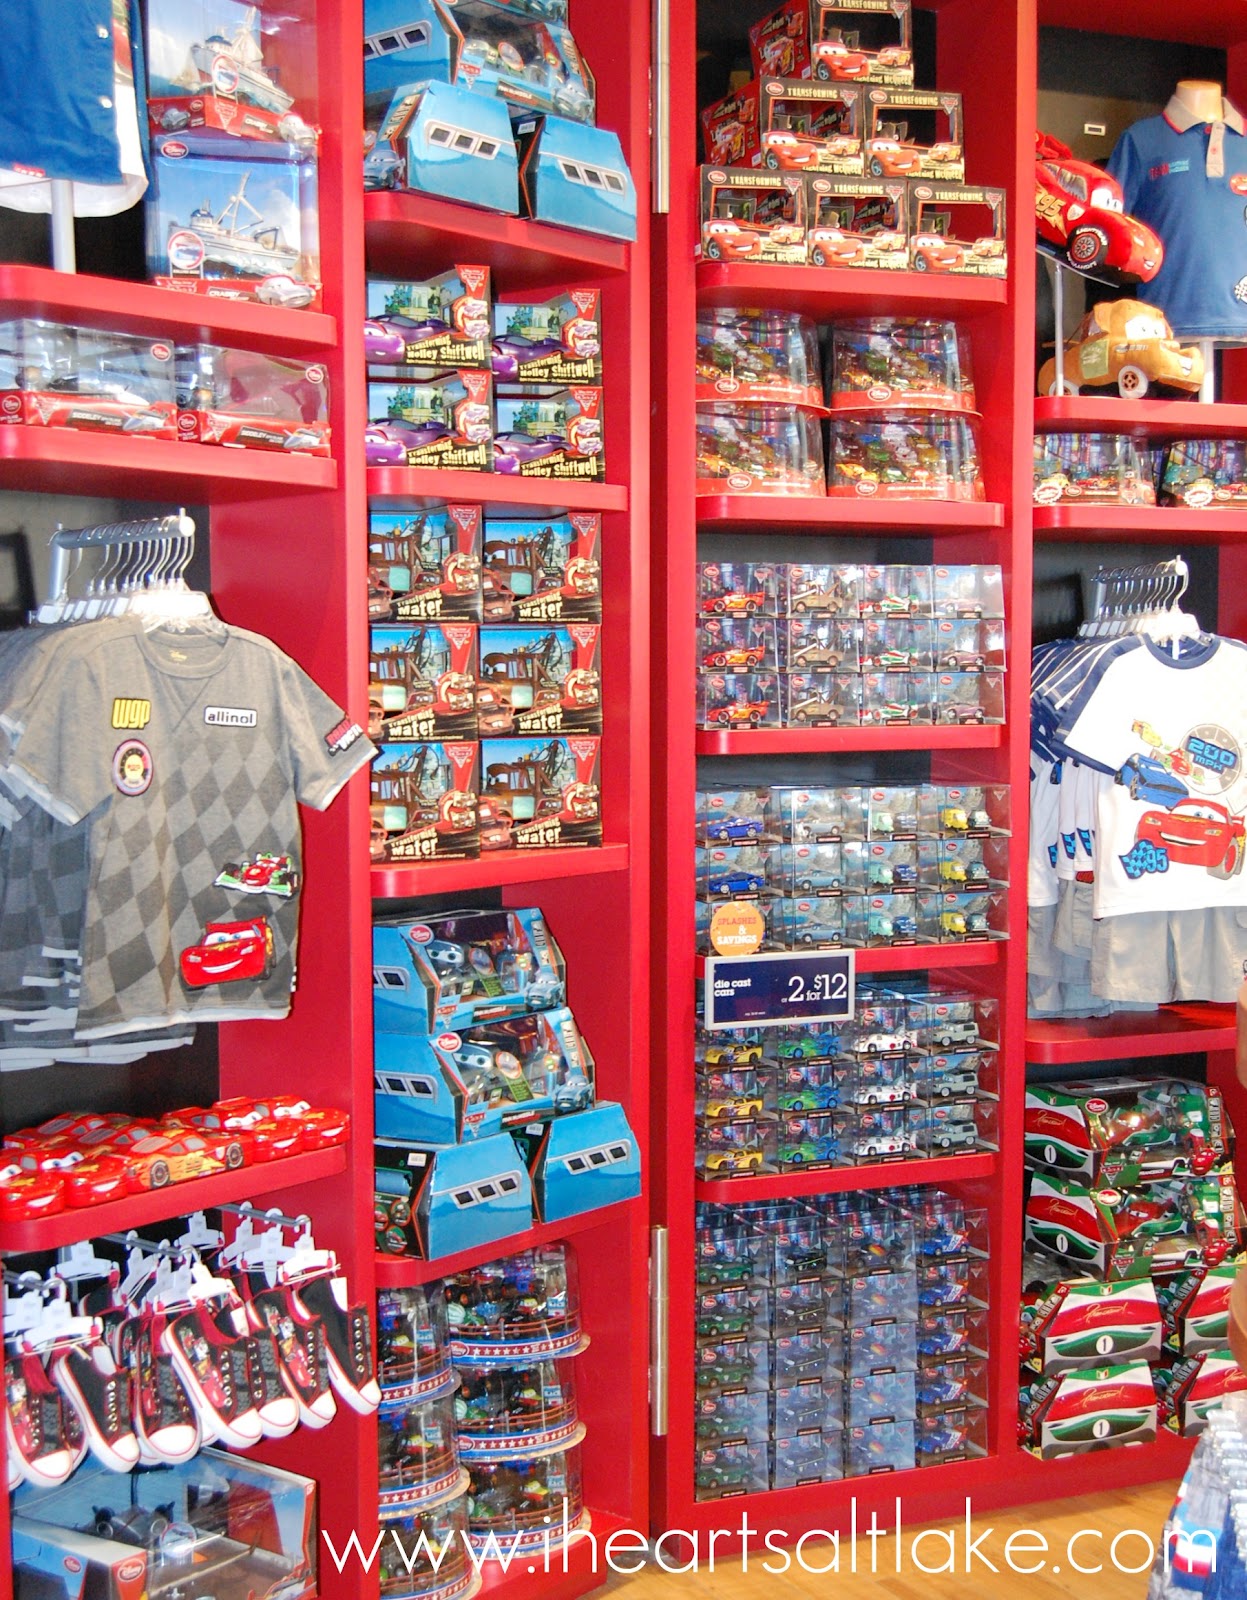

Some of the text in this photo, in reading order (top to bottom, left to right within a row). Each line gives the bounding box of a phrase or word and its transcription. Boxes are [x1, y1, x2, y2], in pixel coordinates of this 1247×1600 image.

[787, 87, 838, 99] TRANSFORMING
[890, 95, 938, 106] TRANSFORMING
[730, 175, 782, 187] TRANSFORMING
[834, 184, 884, 194] TRANSFORMING
[935, 191, 983, 201] TRANSFORMING
[406, 334, 452, 351] Transforming
[440, 340, 484, 361] Shiftwell
[519, 351, 563, 370] Transforming
[551, 358, 594, 378] Shiftwell
[408, 439, 453, 458] Transforming
[441, 444, 486, 465] Shiftwell
[521, 451, 564, 471] Transforming
[554, 457, 597, 477] Shiftwell
[207, 710, 254, 725] allinol
[1187, 737, 1235, 766] 200
[1147, 848, 1167, 872] 95
[717, 916, 757, 926] SPLASHES
[738, 925, 747, 935] &
[716, 934, 757, 945] SAVINGS
[714, 978, 752, 989] die cast
[788, 976, 805, 1002] 2
[813, 973, 847, 1000] $12
[714, 988, 735, 997] cars
[806, 990, 821, 1001] for
